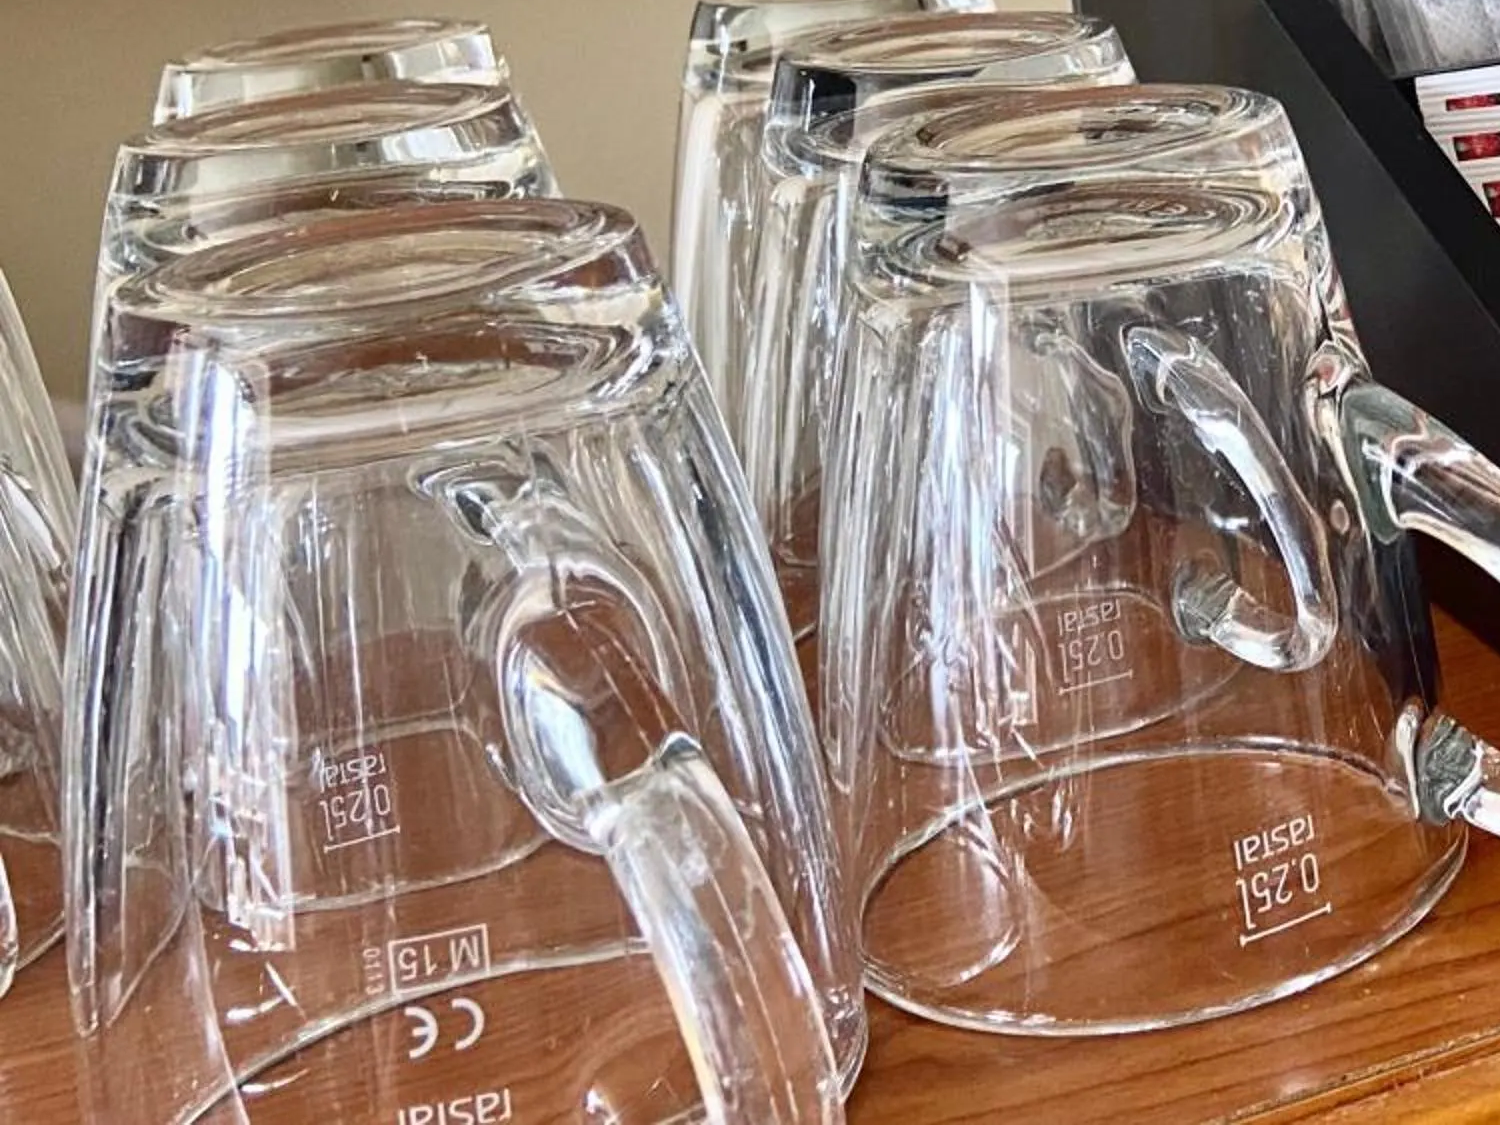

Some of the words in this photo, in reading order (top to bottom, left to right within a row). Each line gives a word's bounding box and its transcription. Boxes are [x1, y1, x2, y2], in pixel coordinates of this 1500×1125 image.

[1057, 598, 1122, 635] rastal
[319, 751, 387, 794] rastal
[1234, 814, 1315, 871] rastal
[398, 946, 440, 980] 15
[451, 933, 479, 971] M
[404, 998, 485, 1059] CE
